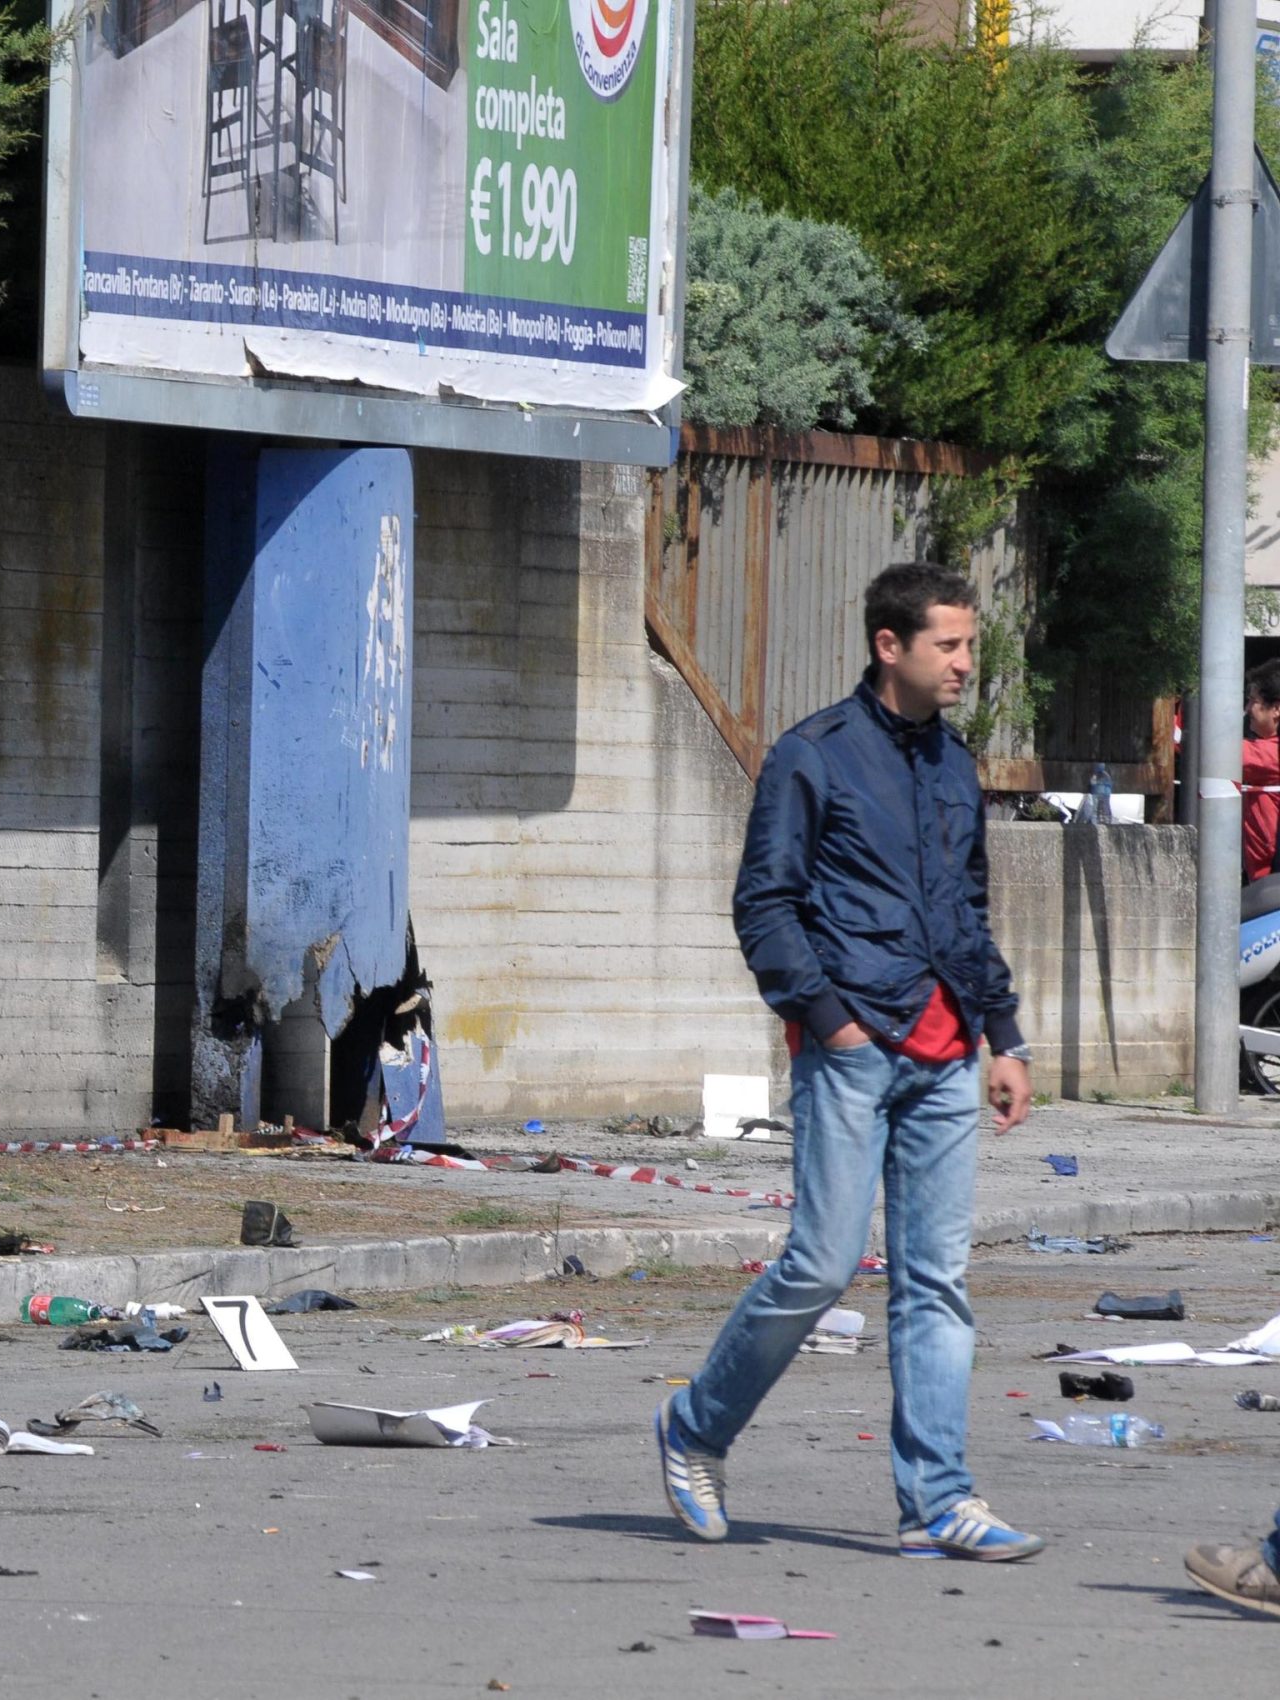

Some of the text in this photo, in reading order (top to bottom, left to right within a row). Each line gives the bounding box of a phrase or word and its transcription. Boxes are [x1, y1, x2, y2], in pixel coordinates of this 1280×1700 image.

[476, 0, 518, 63] Sala
[576, 32, 637, 91] di Convenienza
[475, 75, 566, 151] completa
[131, 269, 169, 299] Fontana
[170, 273, 184, 305] (Br)
[188, 275, 224, 304] Taranto
[261, 280, 278, 313] (Le)
[282, 283, 320, 313] Parabita
[339, 289, 367, 319] Andria
[367, 293, 382, 325] (Bt)
[386, 296, 430, 332] Modugno
[430, 301, 448, 333] (Ba)
[487, 308, 503, 339] (Ba)
[507, 310, 545, 346] Monopoli
[544, 314, 561, 345] (Ba)
[563, 316, 593, 352] Foggia
[596, 320, 627, 350] Policoro
[212, 1299, 258, 1362] 7
